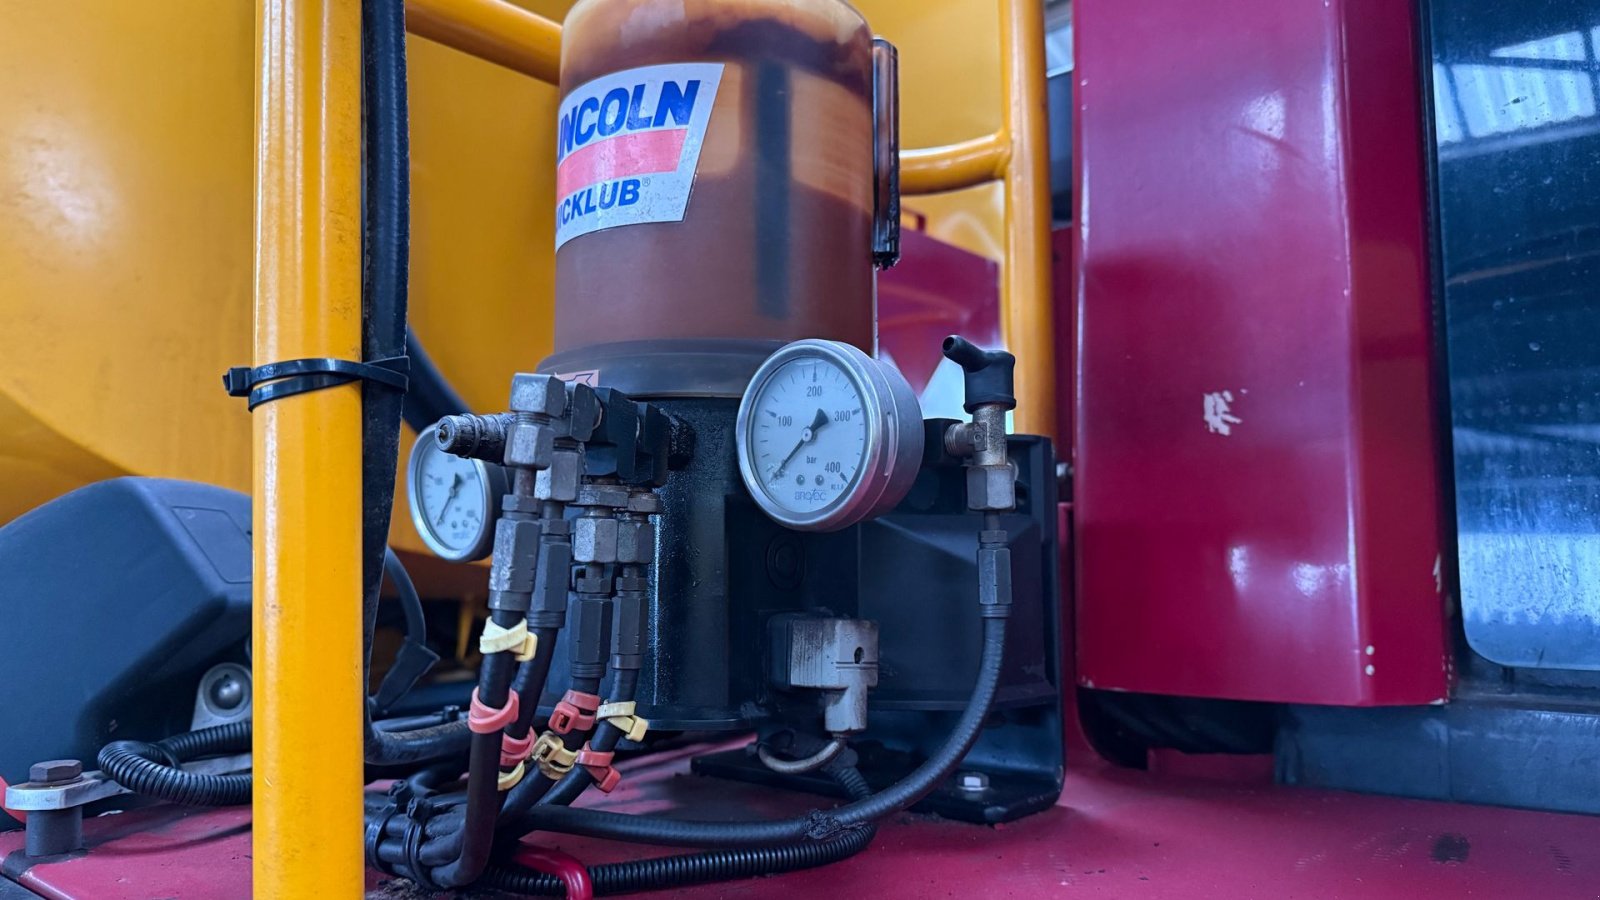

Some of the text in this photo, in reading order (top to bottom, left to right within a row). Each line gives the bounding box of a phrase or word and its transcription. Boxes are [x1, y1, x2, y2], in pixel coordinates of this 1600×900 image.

[558, 80, 700, 162] INCOLN
[557, 179, 641, 230] ICKLUB
[806, 385, 823, 397] 200
[777, 416, 793, 427] 100
[834, 410, 851, 422] 300
[806, 455, 817, 464] bar
[824, 461, 841, 473] 400
